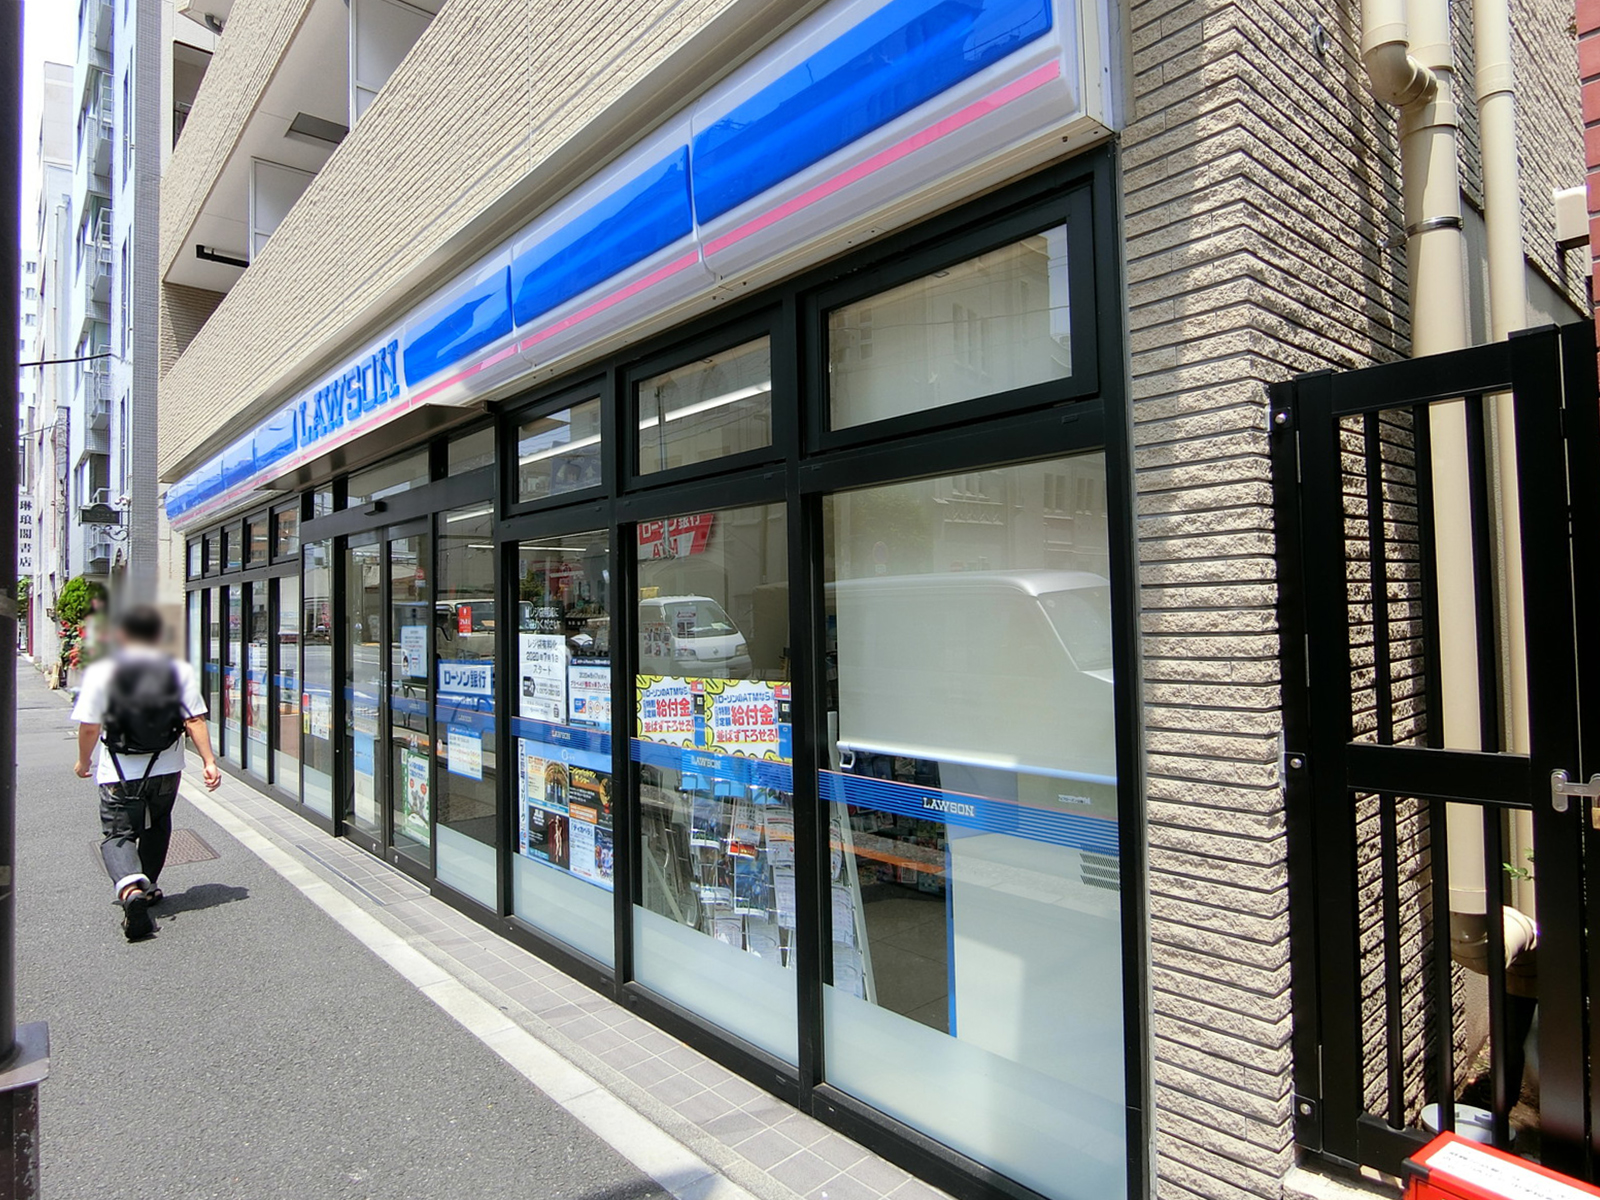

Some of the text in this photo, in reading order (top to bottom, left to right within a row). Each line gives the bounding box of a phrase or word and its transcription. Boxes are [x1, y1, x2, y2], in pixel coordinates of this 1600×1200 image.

[299, 338, 399, 448] LAWSON
[533, 664, 552, 675] スタート
[444, 670, 487, 689] ローソン銀行
[645, 686, 689, 698] ローソンのATMなら
[718, 691, 771, 704] ローソンのATMなら
[656, 697, 691, 717] 給付金
[718, 705, 730, 716] 特別
[719, 717, 731, 727] 定額
[731, 704, 774, 726] 給付金
[690, 755, 722, 770] LAWSON
[922, 797, 975, 817] LAWSON
